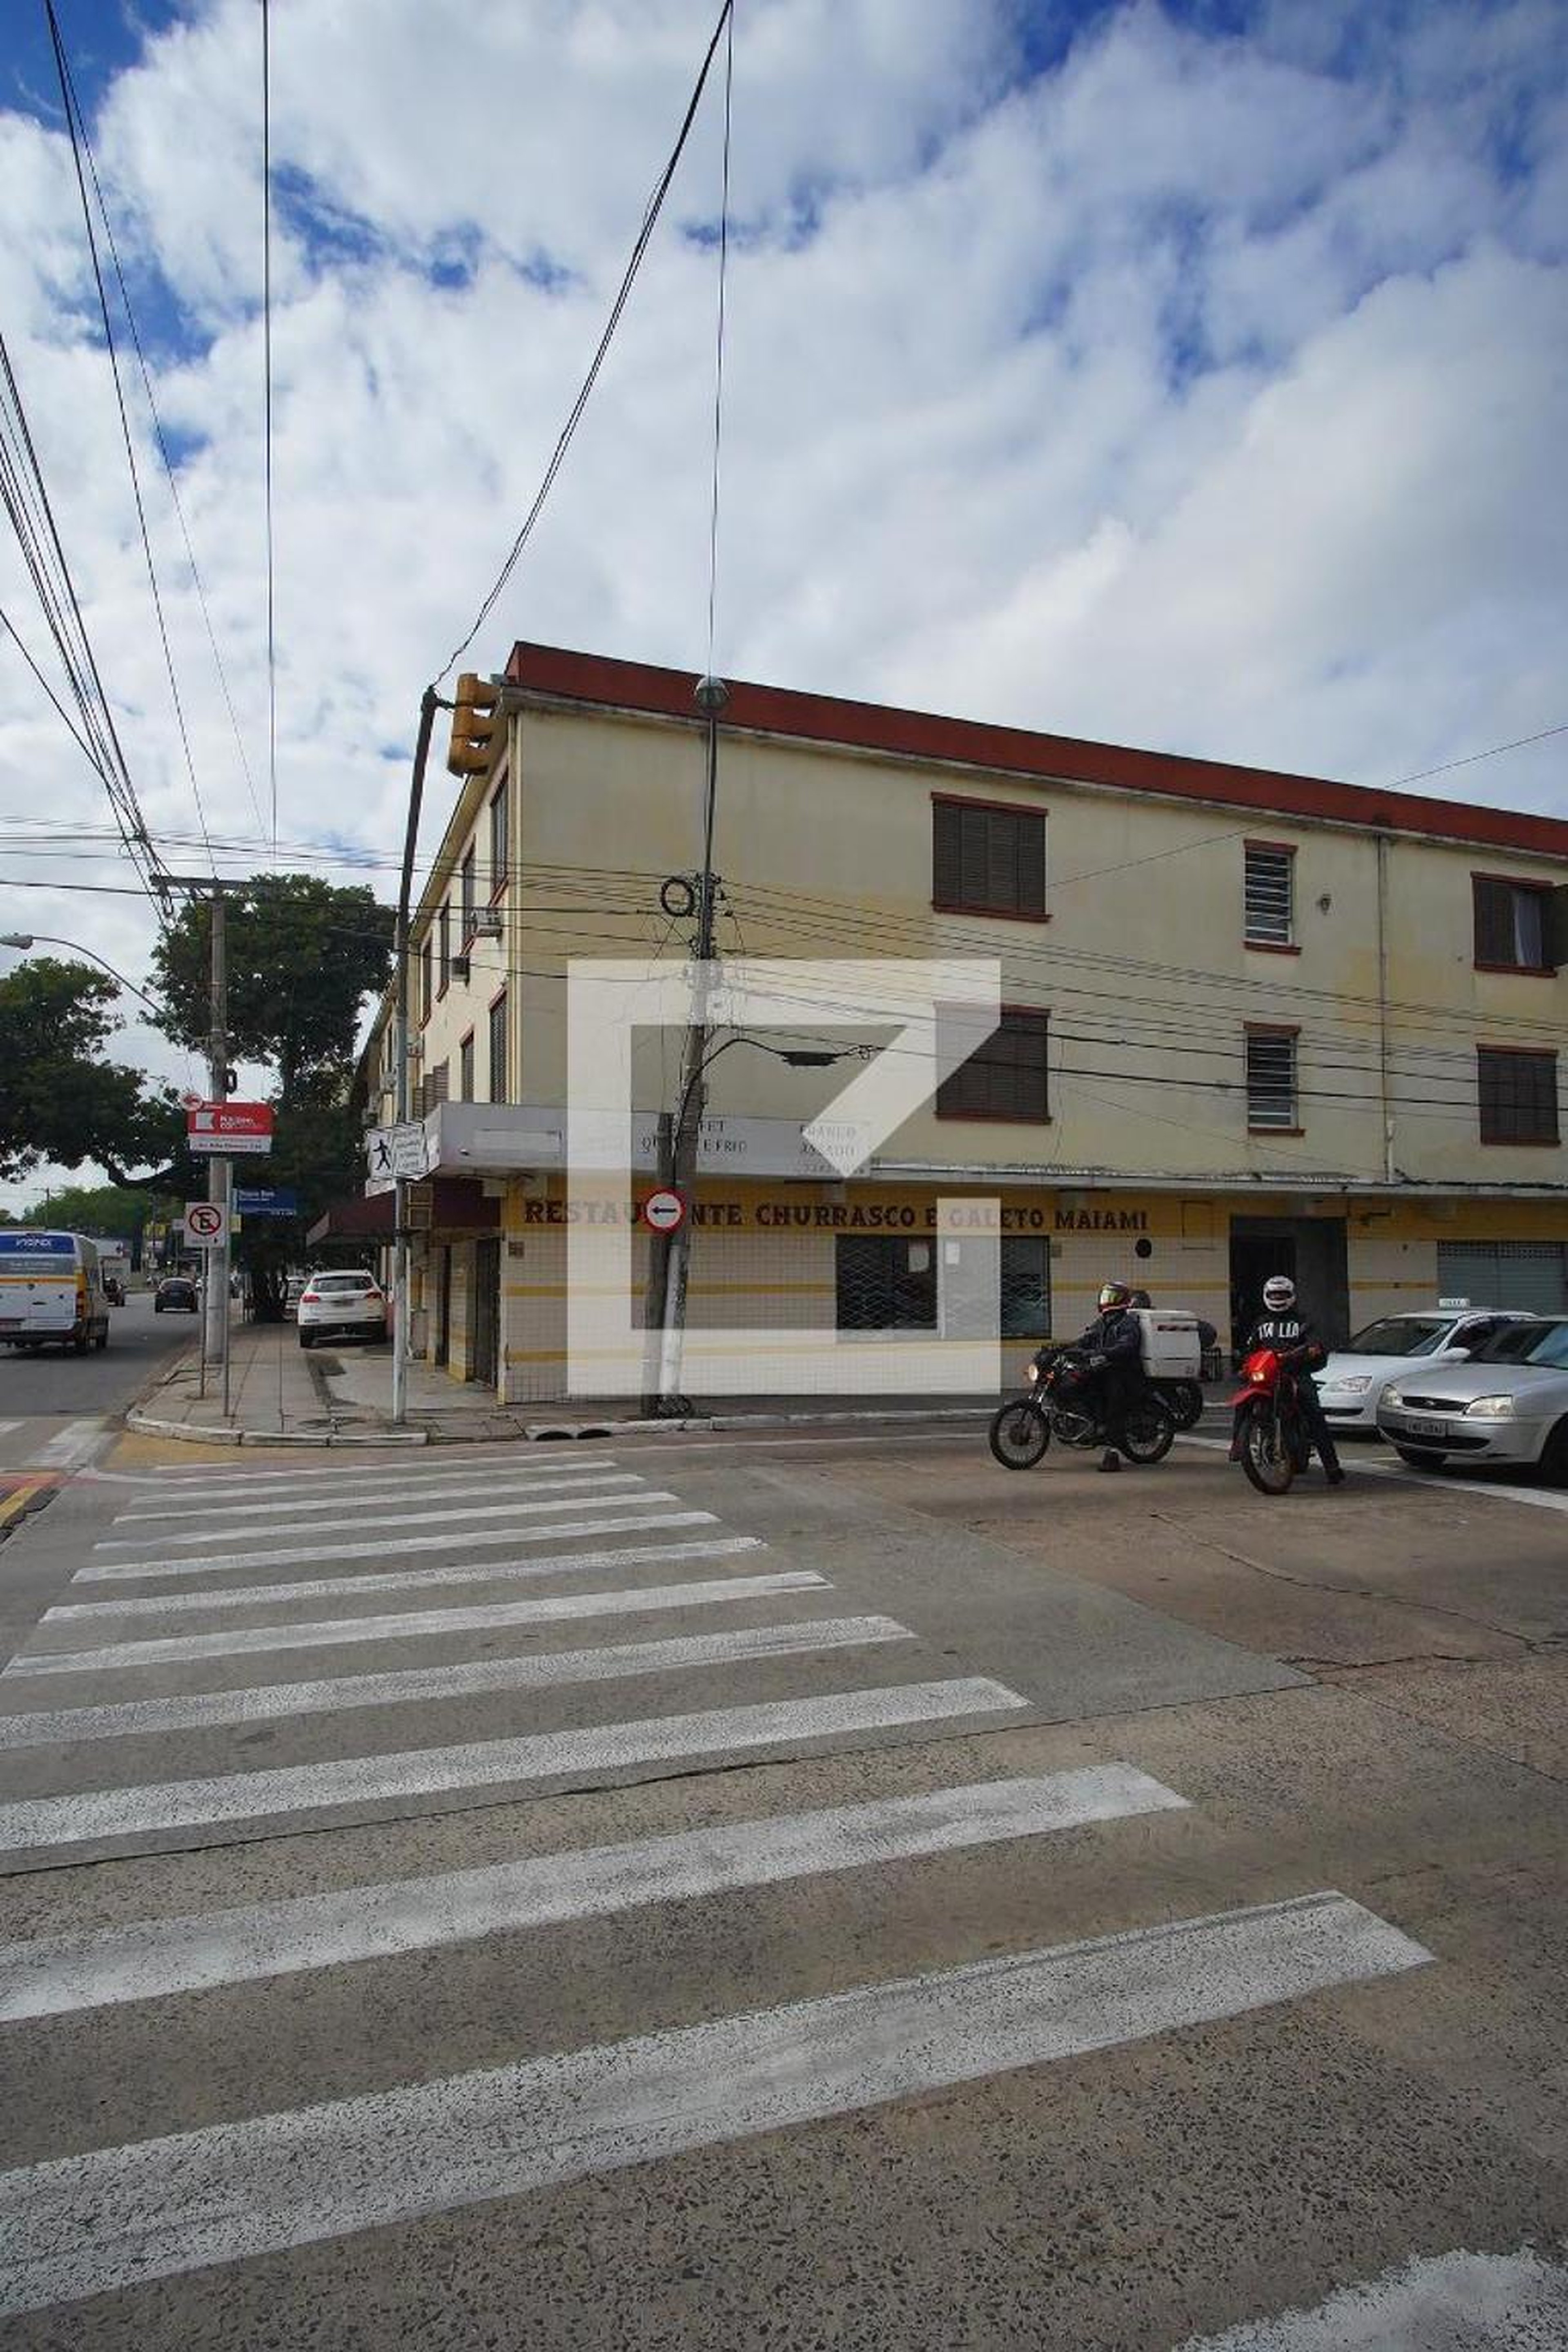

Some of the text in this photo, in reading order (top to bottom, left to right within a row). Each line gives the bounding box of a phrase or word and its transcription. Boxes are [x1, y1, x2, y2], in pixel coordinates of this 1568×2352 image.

[524, 1199, 1147, 1230] RESTAUNTE CHURRASCO E GALETO MAIAMI
